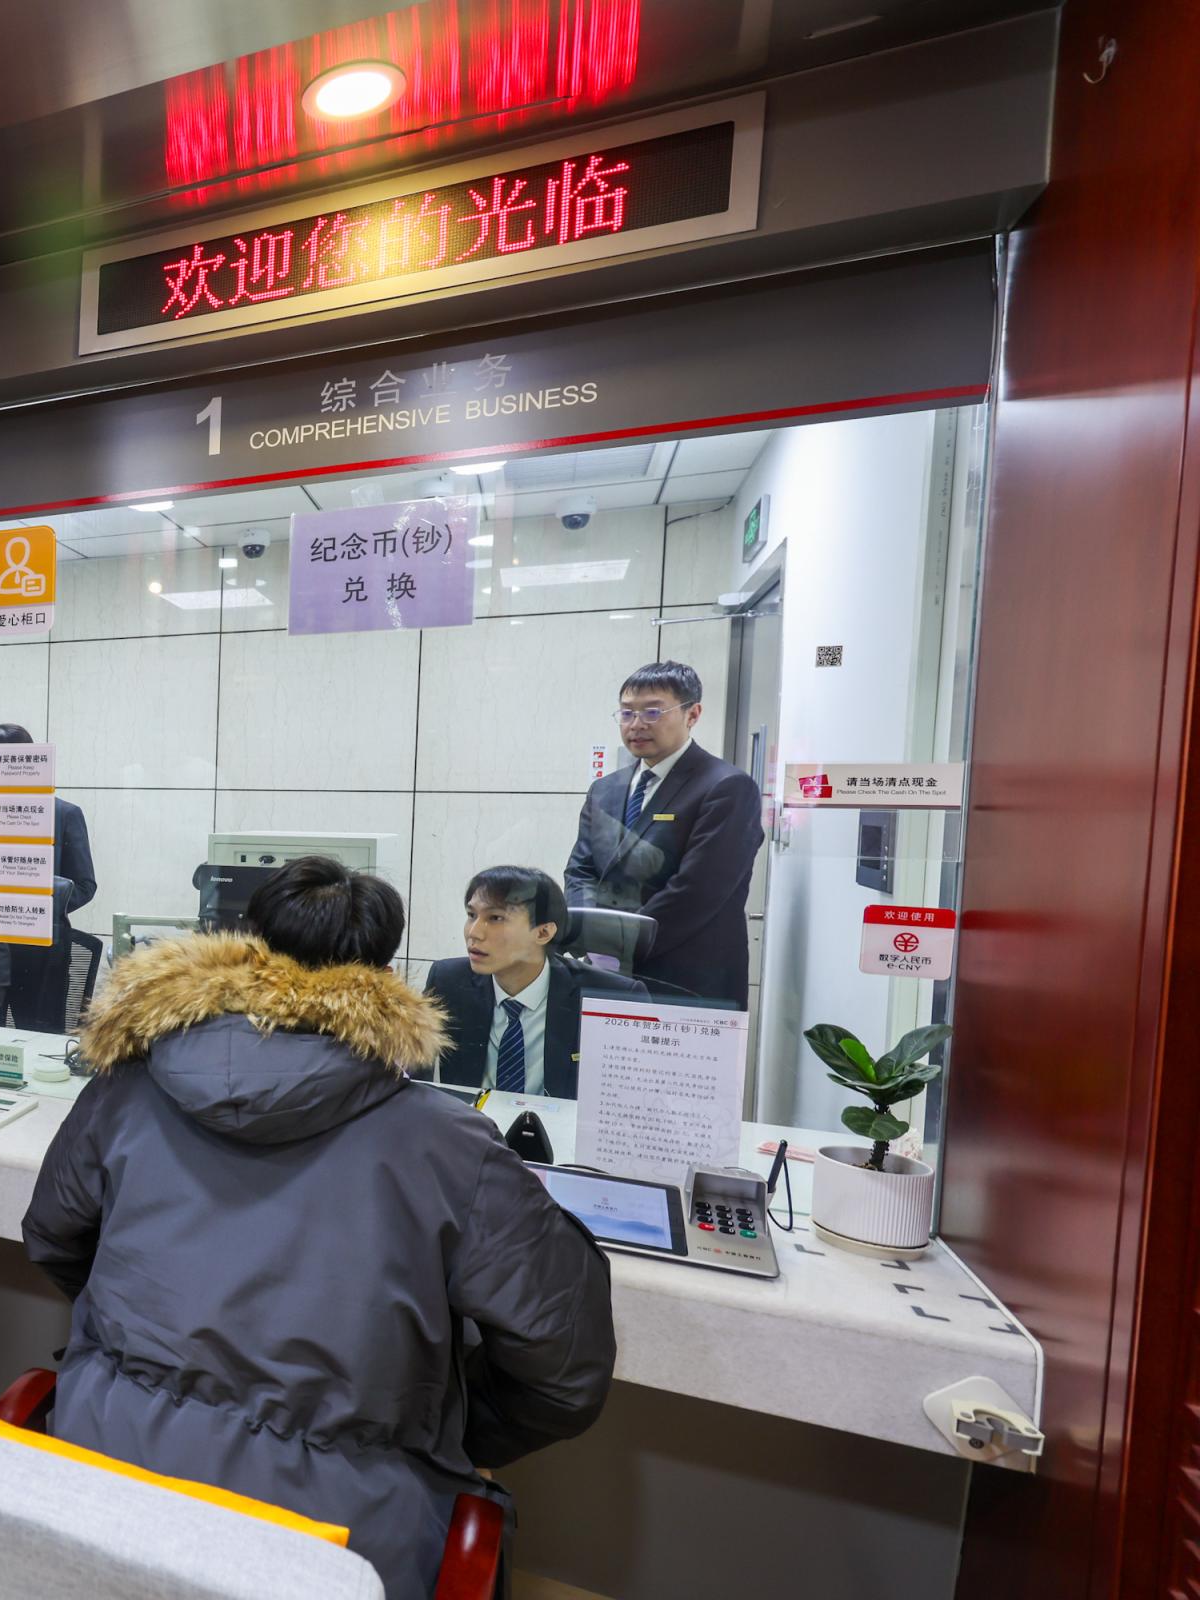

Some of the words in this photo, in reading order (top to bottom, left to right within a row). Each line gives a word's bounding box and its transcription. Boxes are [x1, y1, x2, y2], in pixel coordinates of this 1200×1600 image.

[161, 155, 630, 320] 欢迎您的光临
[321, 353, 513, 413] 综合业务
[249, 405, 451, 450] COMPREHENSIVE
[465, 382, 598, 419] BUSINESS
[195, 396, 222, 456] 1
[310, 524, 453, 562] 纪念币(钞)
[846, 777, 938, 787] 请当场清点现金
[884, 910, 935, 922] 欢迎使用
[879, 954, 932, 965] 数字人民币
[886, 963, 921, 971] e-CNY
[604, 1017, 630, 1027] 2026
[640, 1035, 681, 1047] 温馨提示
